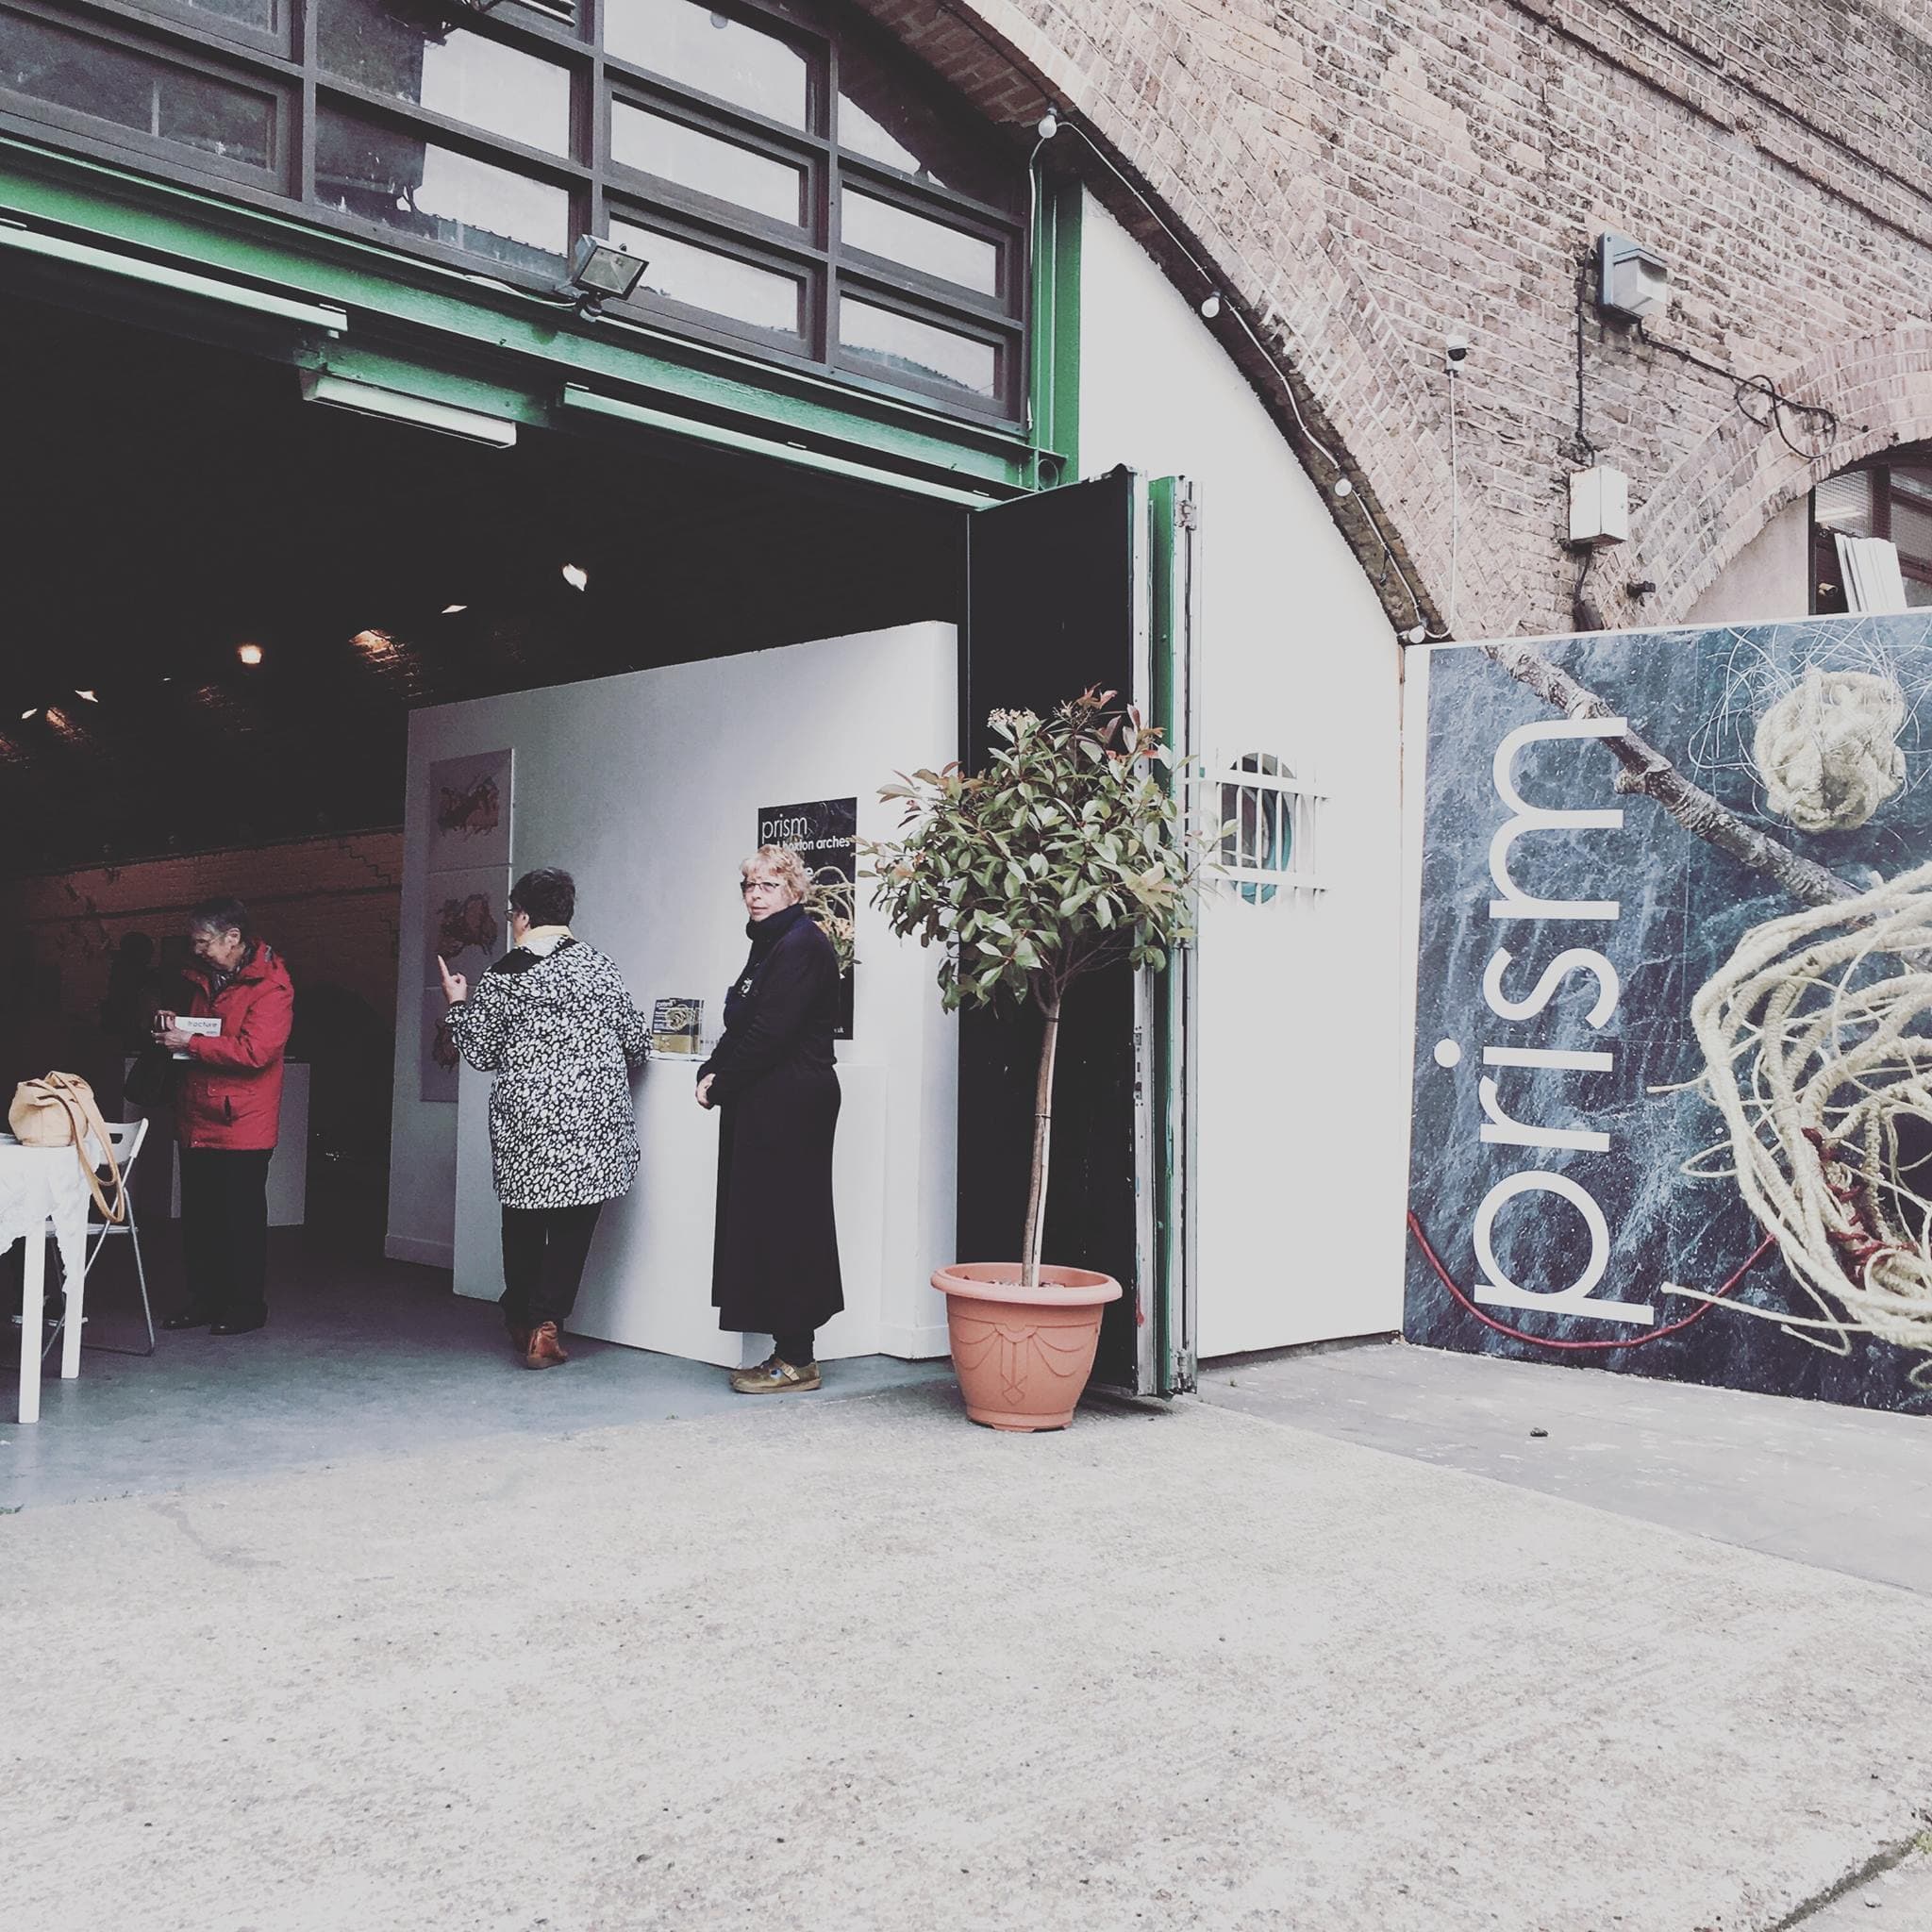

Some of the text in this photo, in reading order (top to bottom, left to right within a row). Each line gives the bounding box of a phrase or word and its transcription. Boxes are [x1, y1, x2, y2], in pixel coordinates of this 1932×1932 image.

[761, 813, 808, 844] prism
[816, 836, 850, 849] arches
[1434, 717, 1655, 1325] prism
